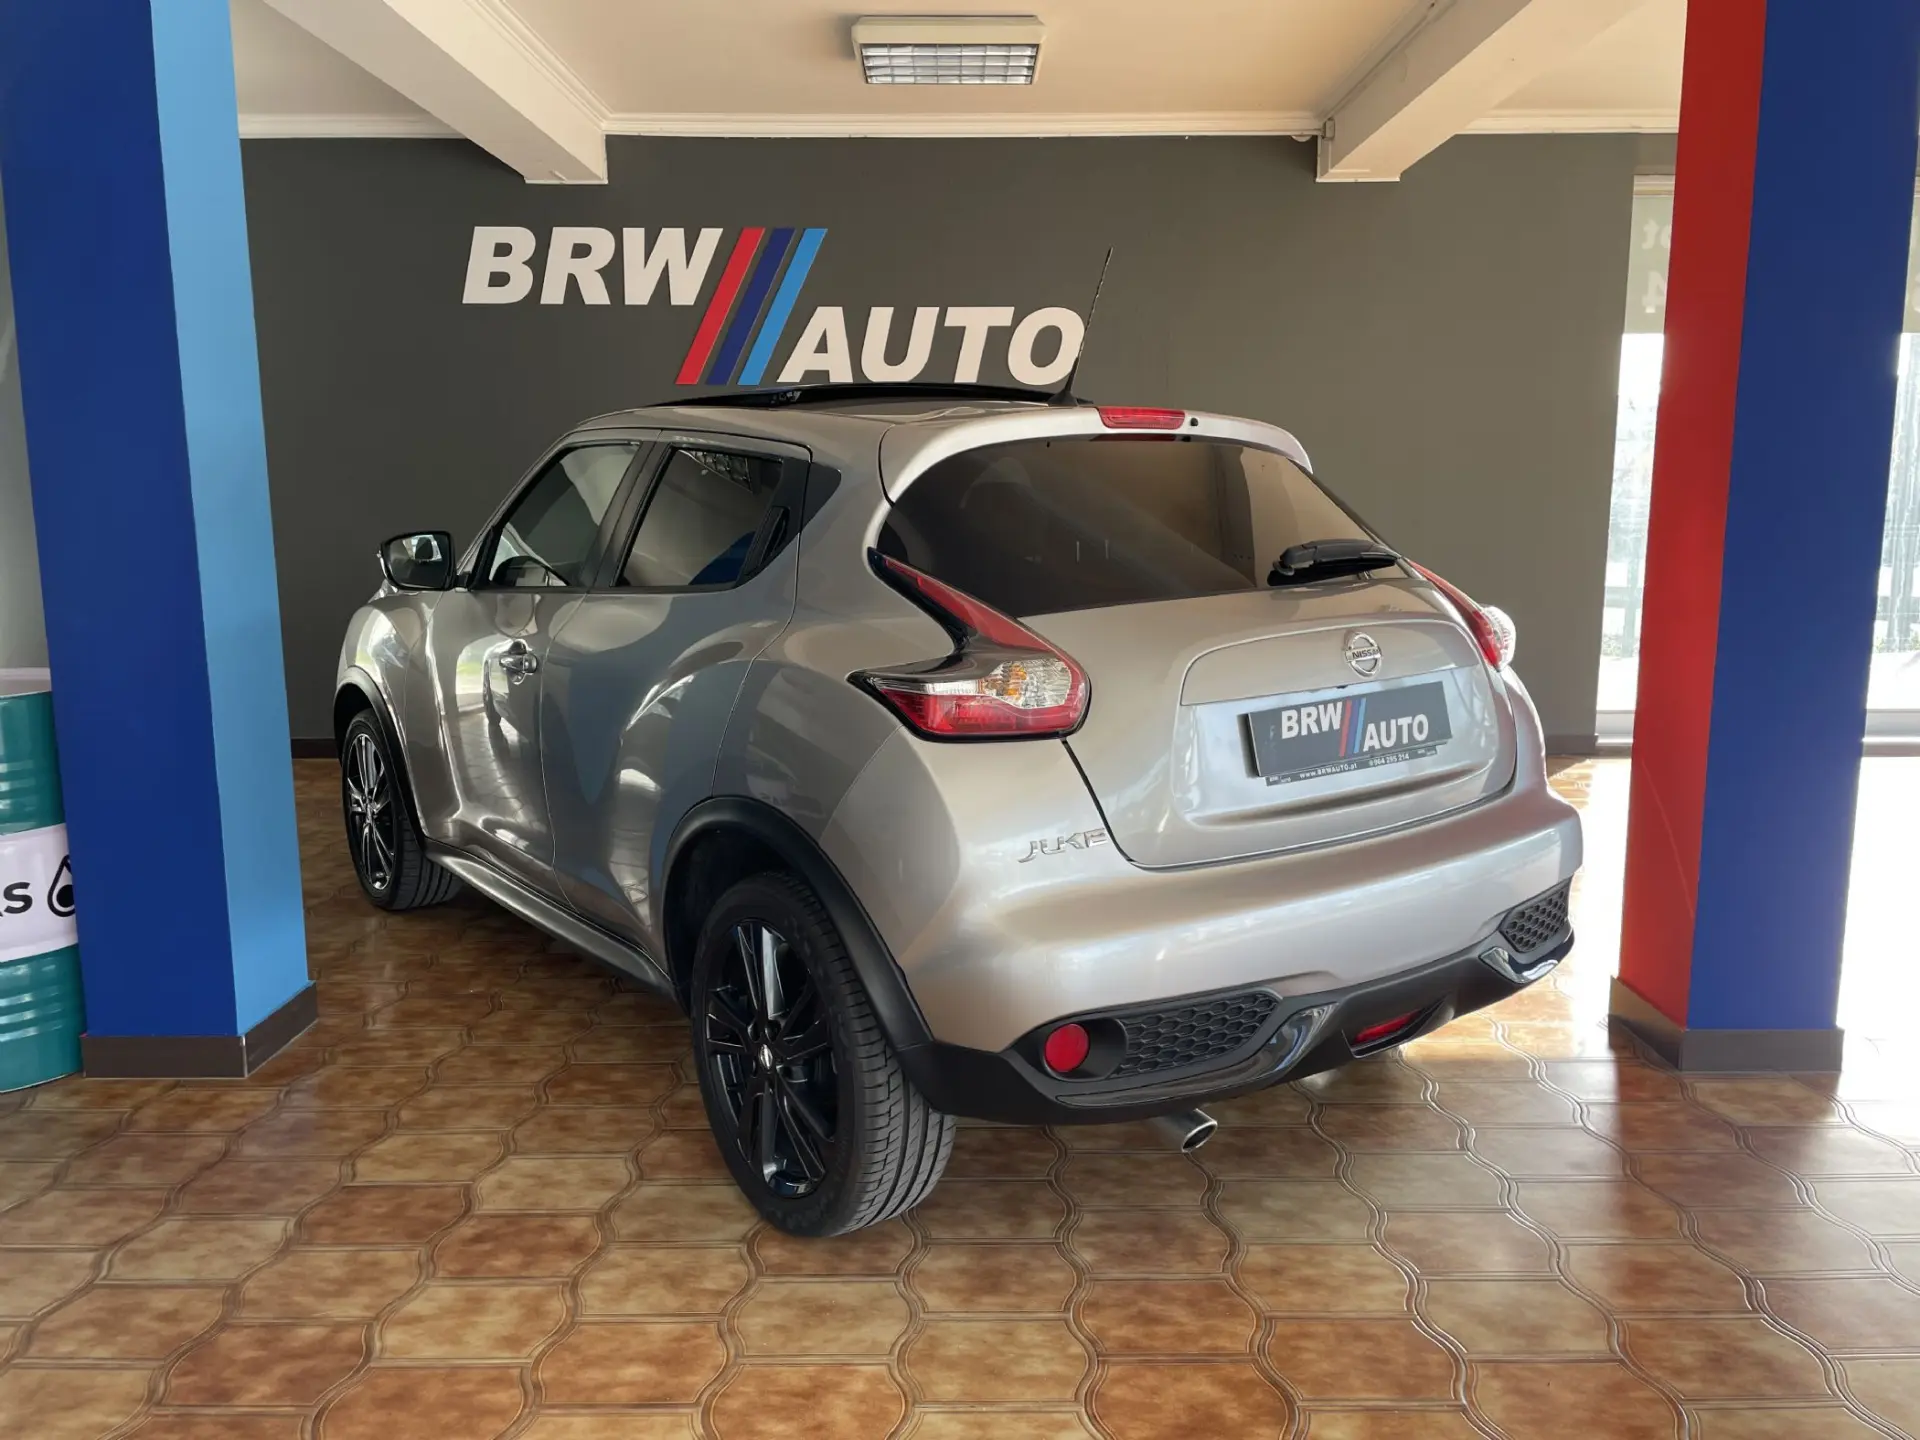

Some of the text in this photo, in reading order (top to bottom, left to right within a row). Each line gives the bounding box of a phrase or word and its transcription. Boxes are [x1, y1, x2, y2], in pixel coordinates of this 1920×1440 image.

[462, 226, 723, 305] BRW
[776, 306, 1086, 386] AUTO
[1281, 701, 1343, 739] BRW
[1363, 713, 1429, 752] AUTO
[1017, 828, 1108, 863] JUKE
